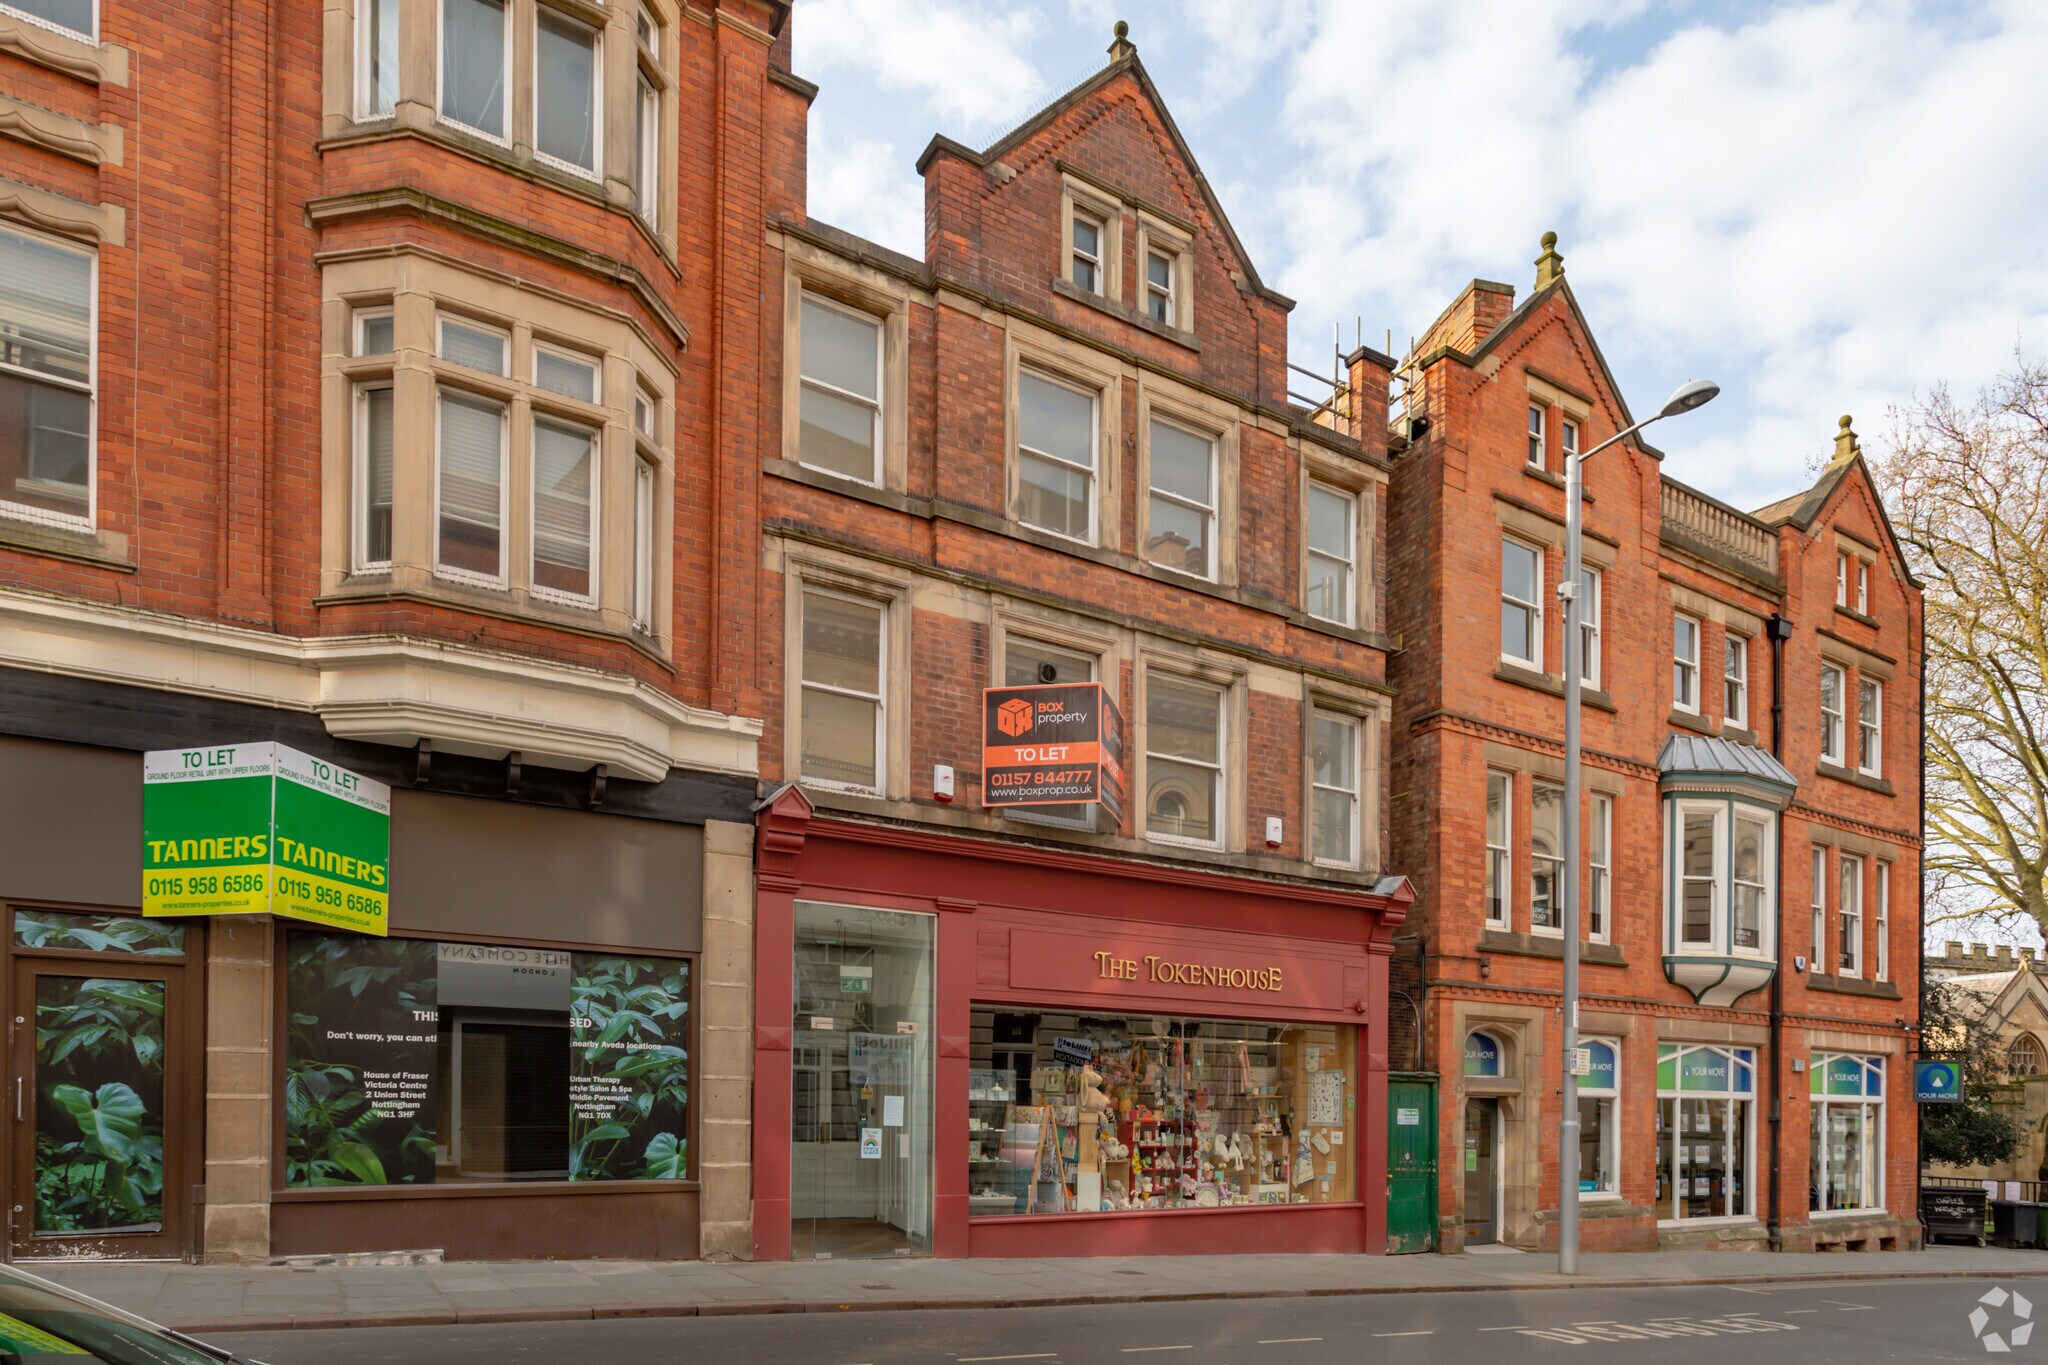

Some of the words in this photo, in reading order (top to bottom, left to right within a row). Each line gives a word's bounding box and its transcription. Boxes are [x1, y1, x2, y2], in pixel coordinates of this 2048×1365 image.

[1038, 702, 1064, 713] BOX
[1038, 712, 1087, 725] property
[182, 752, 202, 768] TO
[208, 748, 236, 766] LET
[1014, 748, 1036, 762] TO
[1039, 746, 1069, 760] LET
[147, 772, 169, 780] GROUND
[170, 771, 187, 779] FLOOR
[188, 770, 205, 778] RETAIL
[206, 769, 217, 777] UNIT
[249, 765, 270, 773] FLOORS
[310, 760, 330, 780] TO
[335, 769, 359, 791] LET
[991, 773, 1031, 786] 01157
[1034, 770, 1093, 784] 844777
[277, 766, 299, 780] GROUND
[300, 775, 316, 785] FLOOR
[317, 780, 332, 793] RETAIL
[333, 785, 343, 796] UNIT
[344, 790, 355, 799] WITH
[356, 795, 370, 805] UPPER
[370, 800, 387, 811] FLOORS
[991, 784, 1092, 797] www.boxprop.co.uk
[147, 834, 267, 863] TANNERS
[277, 836, 385, 886] TANNERS
[149, 878, 183, 896] 0115
[188, 876, 217, 895] 958
[223, 874, 263, 893] 6586
[278, 876, 311, 900] 0115
[316, 885, 342, 907] 958
[347, 893, 382, 916] 6586
[162, 899, 250, 909] www.tanners-properties.co.uk
[1094, 951, 1139, 980] THE
[1144, 955, 1283, 992] TOKENHOUSE
[327, 1031, 353, 1040] Don't
[355, 1033, 384, 1042] worry,
[572, 1041, 599, 1049] nearby
[601, 1041, 625, 1049] Aveda
[626, 1042, 662, 1050] locations
[1477, 1050, 1495, 1059] MOVE
[1597, 1063, 1612, 1071] MOVE
[1691, 1066, 1707, 1076] YOUR
[1708, 1067, 1725, 1077] MOVE
[363, 1071, 390, 1079] House
[402, 1072, 429, 1080] Fraser
[593, 1076, 621, 1084] Therapy
[1834, 1073, 1846, 1081] YOUR
[1847, 1074, 1860, 1082] MOVE
[374, 1091, 398, 1099] Union
[400, 1091, 426, 1099] Street
[371, 1101, 420, 1110] Nottingham
[1515, 1318, 1800, 1345] DISABLED
